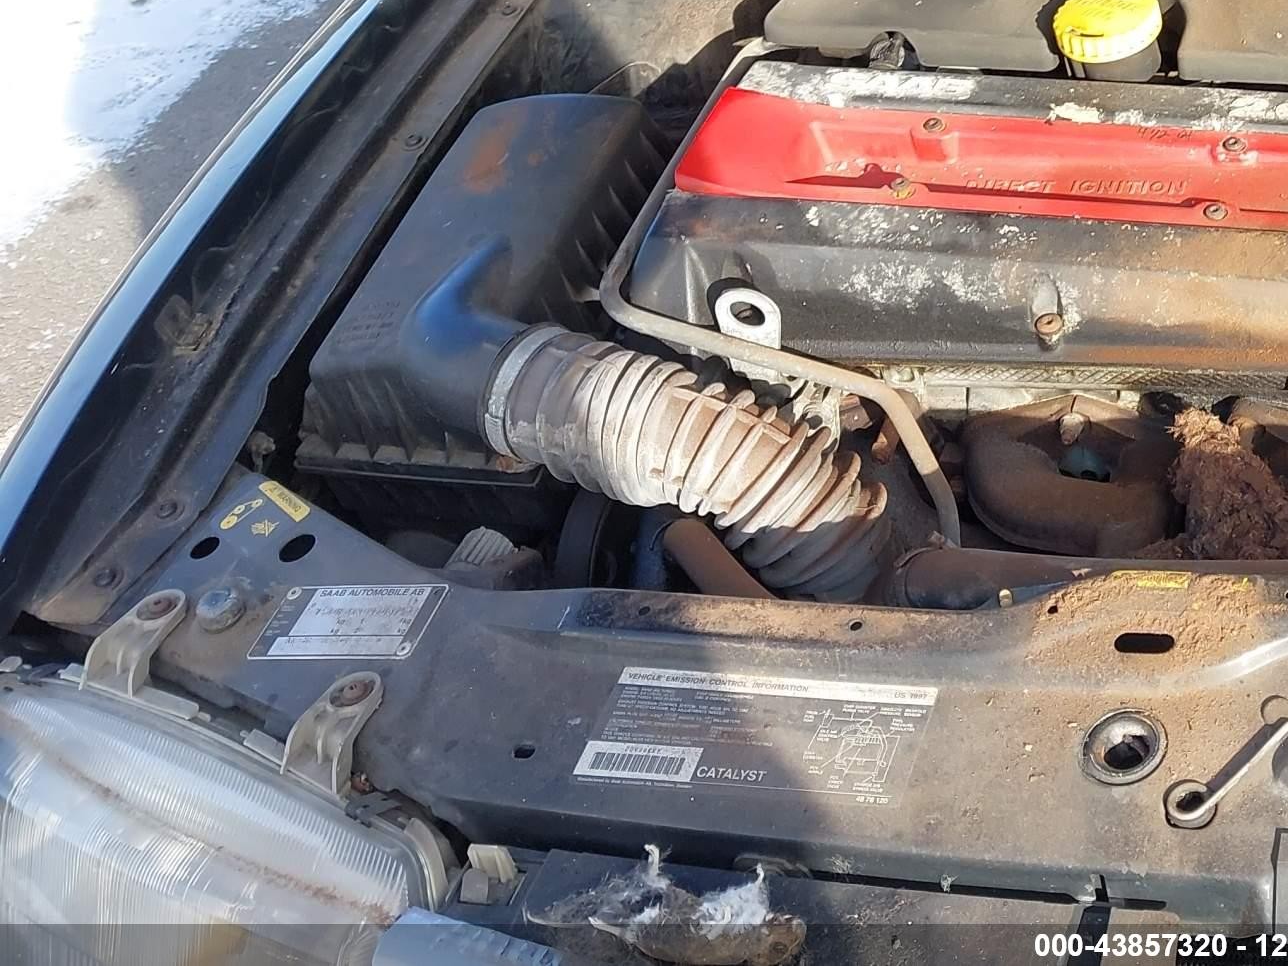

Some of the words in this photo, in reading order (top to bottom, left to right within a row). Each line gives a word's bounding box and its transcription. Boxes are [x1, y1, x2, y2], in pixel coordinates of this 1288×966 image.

[1068, 177, 1190, 196] IGNITION
[320, 589, 347, 598] SAAB
[348, 588, 409, 597] AUTOMOBILE
[410, 588, 425, 596] AB
[628, 672, 661, 681] VEHICLE
[665, 675, 706, 685] EMISSION
[708, 679, 747, 688] CONTROL
[751, 682, 809, 693] INFORMATION
[894, 692, 906, 700] US
[696, 766, 767, 783] CATALYST
